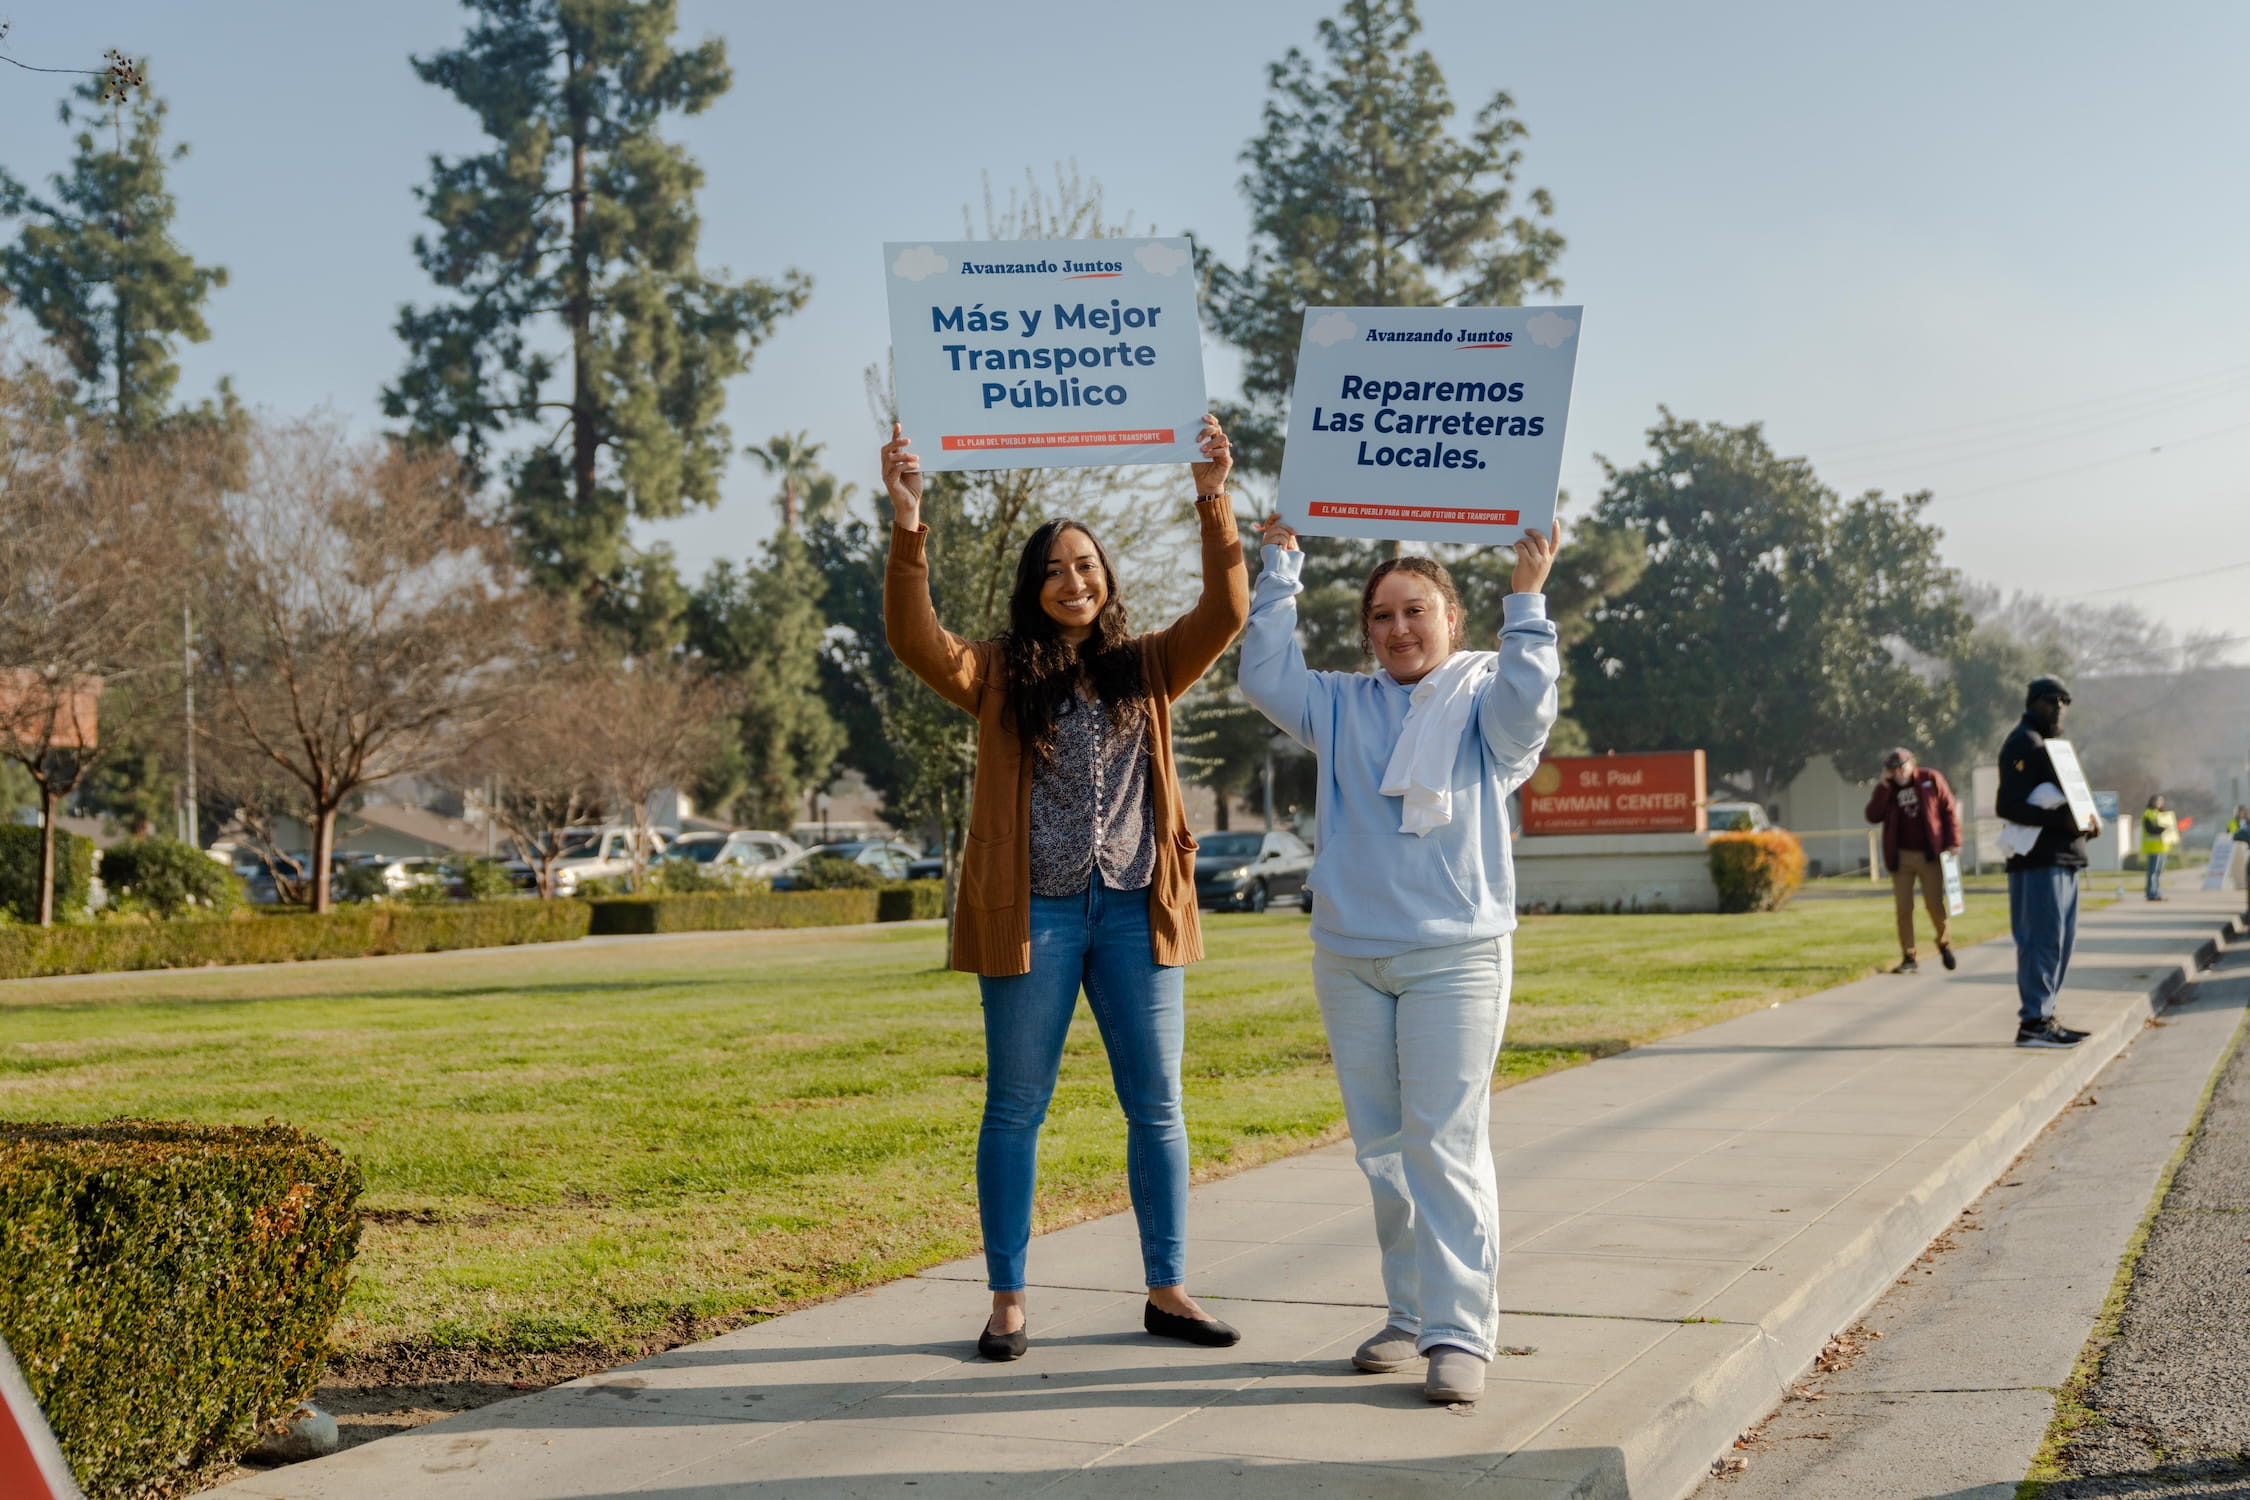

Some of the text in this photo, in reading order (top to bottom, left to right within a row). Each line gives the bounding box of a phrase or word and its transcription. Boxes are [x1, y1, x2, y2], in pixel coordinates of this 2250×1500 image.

[961, 260, 1123, 275] Avanzando Juntos
[931, 299, 1161, 338] Más y Mejor
[1366, 328, 1513, 343] Avanzando Juntos
[943, 342, 1156, 375] Transporte
[982, 377, 1127, 409] Público
[1341, 375, 1524, 406] Reparemos
[1312, 407, 1545, 436] Las Carreteras
[957, 432, 1161, 447] EL PLAN DEL PUEBLO PARA UN MEJOR FUTURO DE TRANSPORTE
[1357, 441, 1486, 469] Locales.
[1331, 506, 1346, 514] PLAN
[1348, 507, 1358, 515] DEL
[1360, 508, 1383, 516] PUEBLO
[1384, 509, 1400, 517] PARA
[1411, 510, 1431, 518] MEJOR
[1432, 511, 1456, 519] FUTURO
[1457, 512, 1465, 520] DE
[1467, 512, 1506, 521] TRANSPORTE
[1579, 769, 1642, 788] St. Paul
[1531, 792, 1687, 813] NEWMAN CENTER
